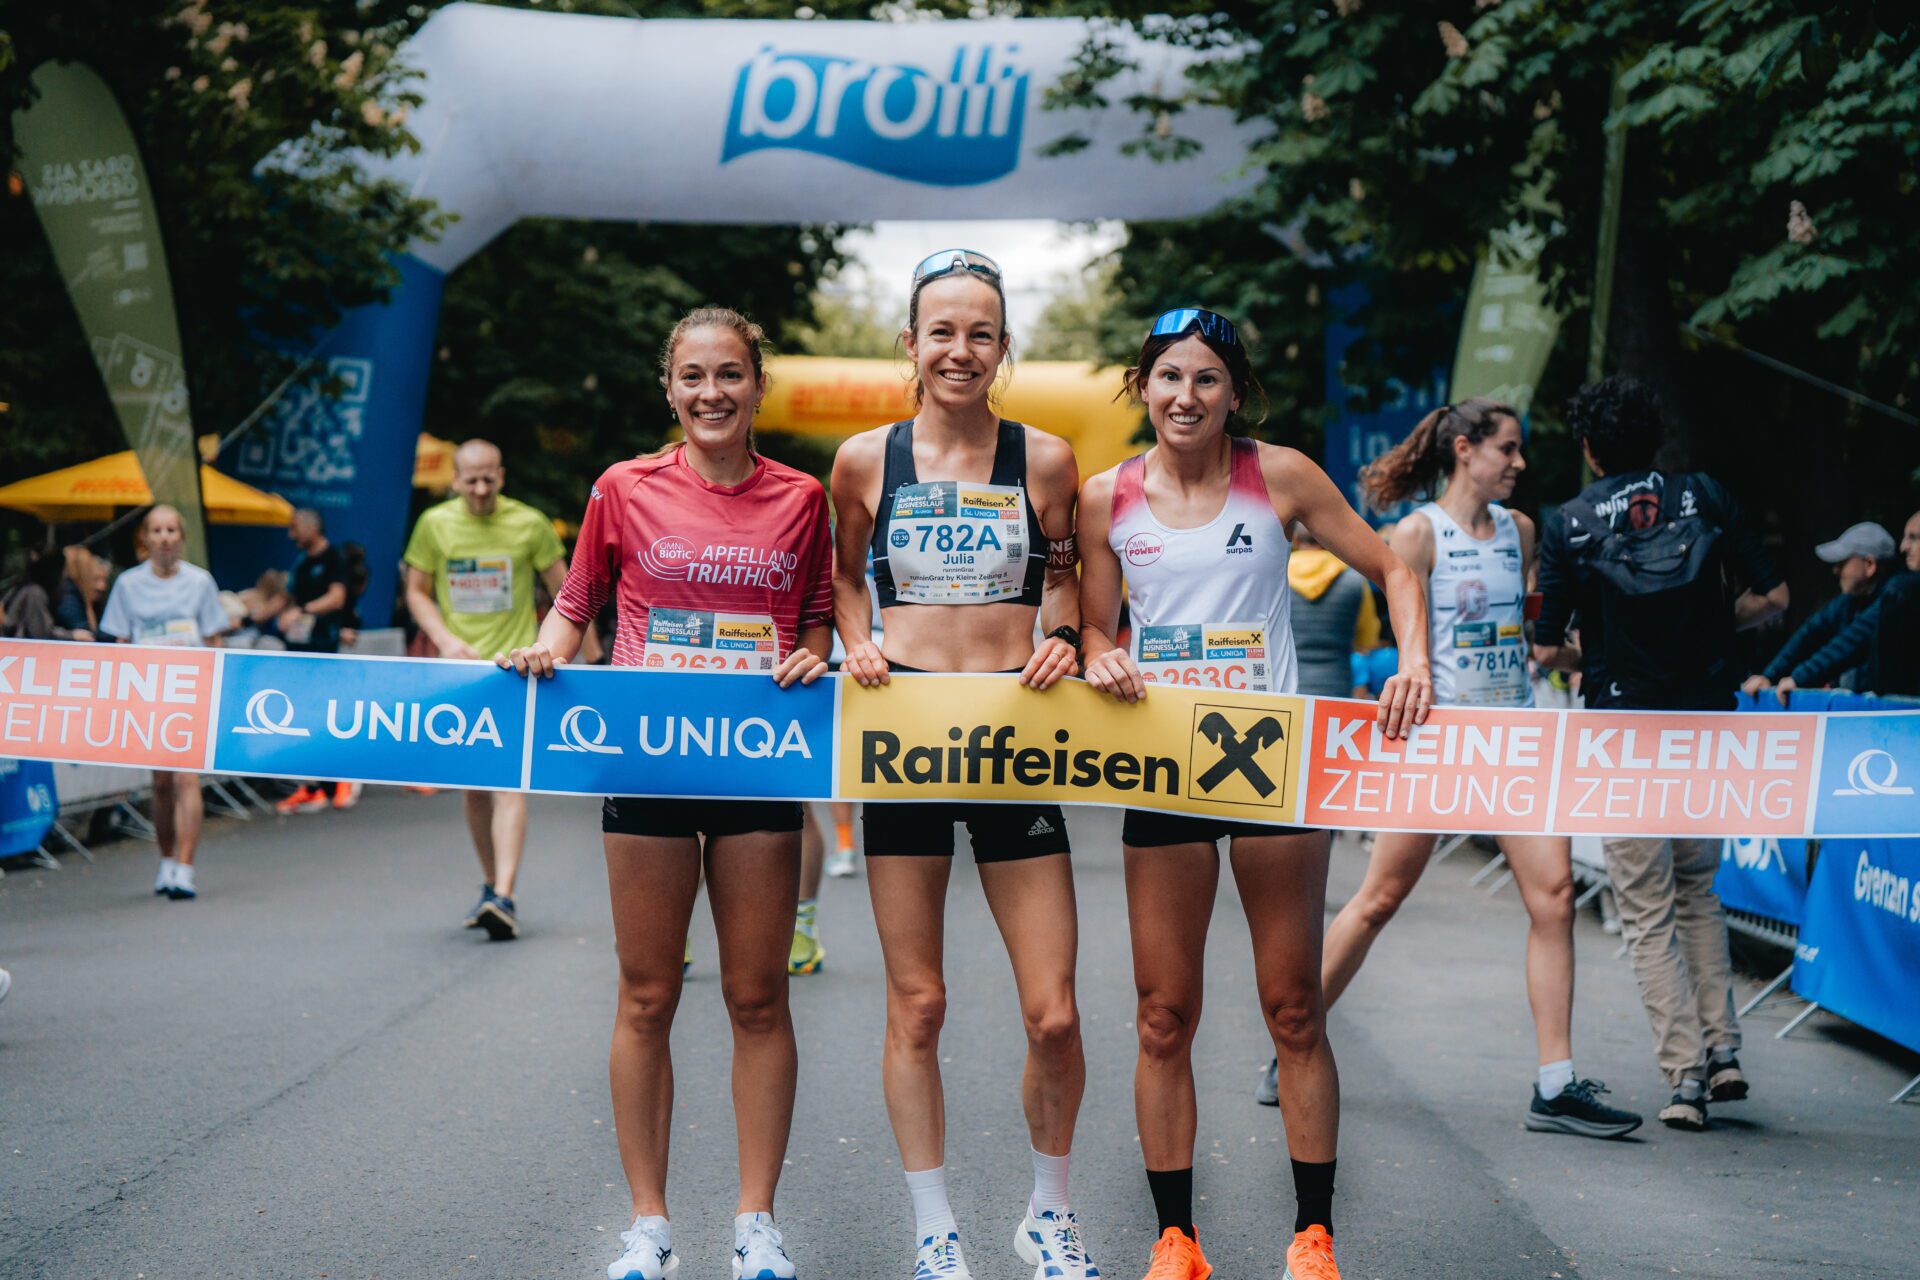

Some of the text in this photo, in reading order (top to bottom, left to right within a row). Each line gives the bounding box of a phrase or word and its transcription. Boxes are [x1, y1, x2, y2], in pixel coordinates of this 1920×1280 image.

[739, 44, 1029, 140] brolli
[962, 496, 1004, 508] Raiffeisen
[974, 510, 997, 518] UNIQA
[915, 524, 1002, 552] 782A
[700, 544, 798, 571] APFELLAND
[942, 553, 975, 565] Julia
[1129, 545, 1161, 557] POWER
[1226, 546, 1253, 555] surpas
[686, 562, 796, 593] TRIATHLON
[956, 573, 977, 581] Kleine
[652, 625, 701, 637] BUSINESSLAUF
[719, 628, 762, 639] Raiffeisen
[1208, 638, 1251, 647] Raiffeisen
[730, 641, 753, 650] UNIQA
[1143, 643, 1190, 652] BUSINESSLAUF
[1474, 649, 1521, 673] 781A
[1162, 665, 1247, 690] 263C
[0, 702, 194, 753] EITUNG
[326, 699, 504, 748] UNIQA
[639, 715, 813, 759] UNIQA
[1325, 716, 1543, 767] KLEINE
[1576, 728, 1801, 770] KLEINE
[861, 725, 1180, 796] Raiffeisen
[1319, 768, 1536, 817] ZEITUNG
[1568, 777, 1793, 819] ZEITUNG
[1027, 826, 1055, 836] adidas
